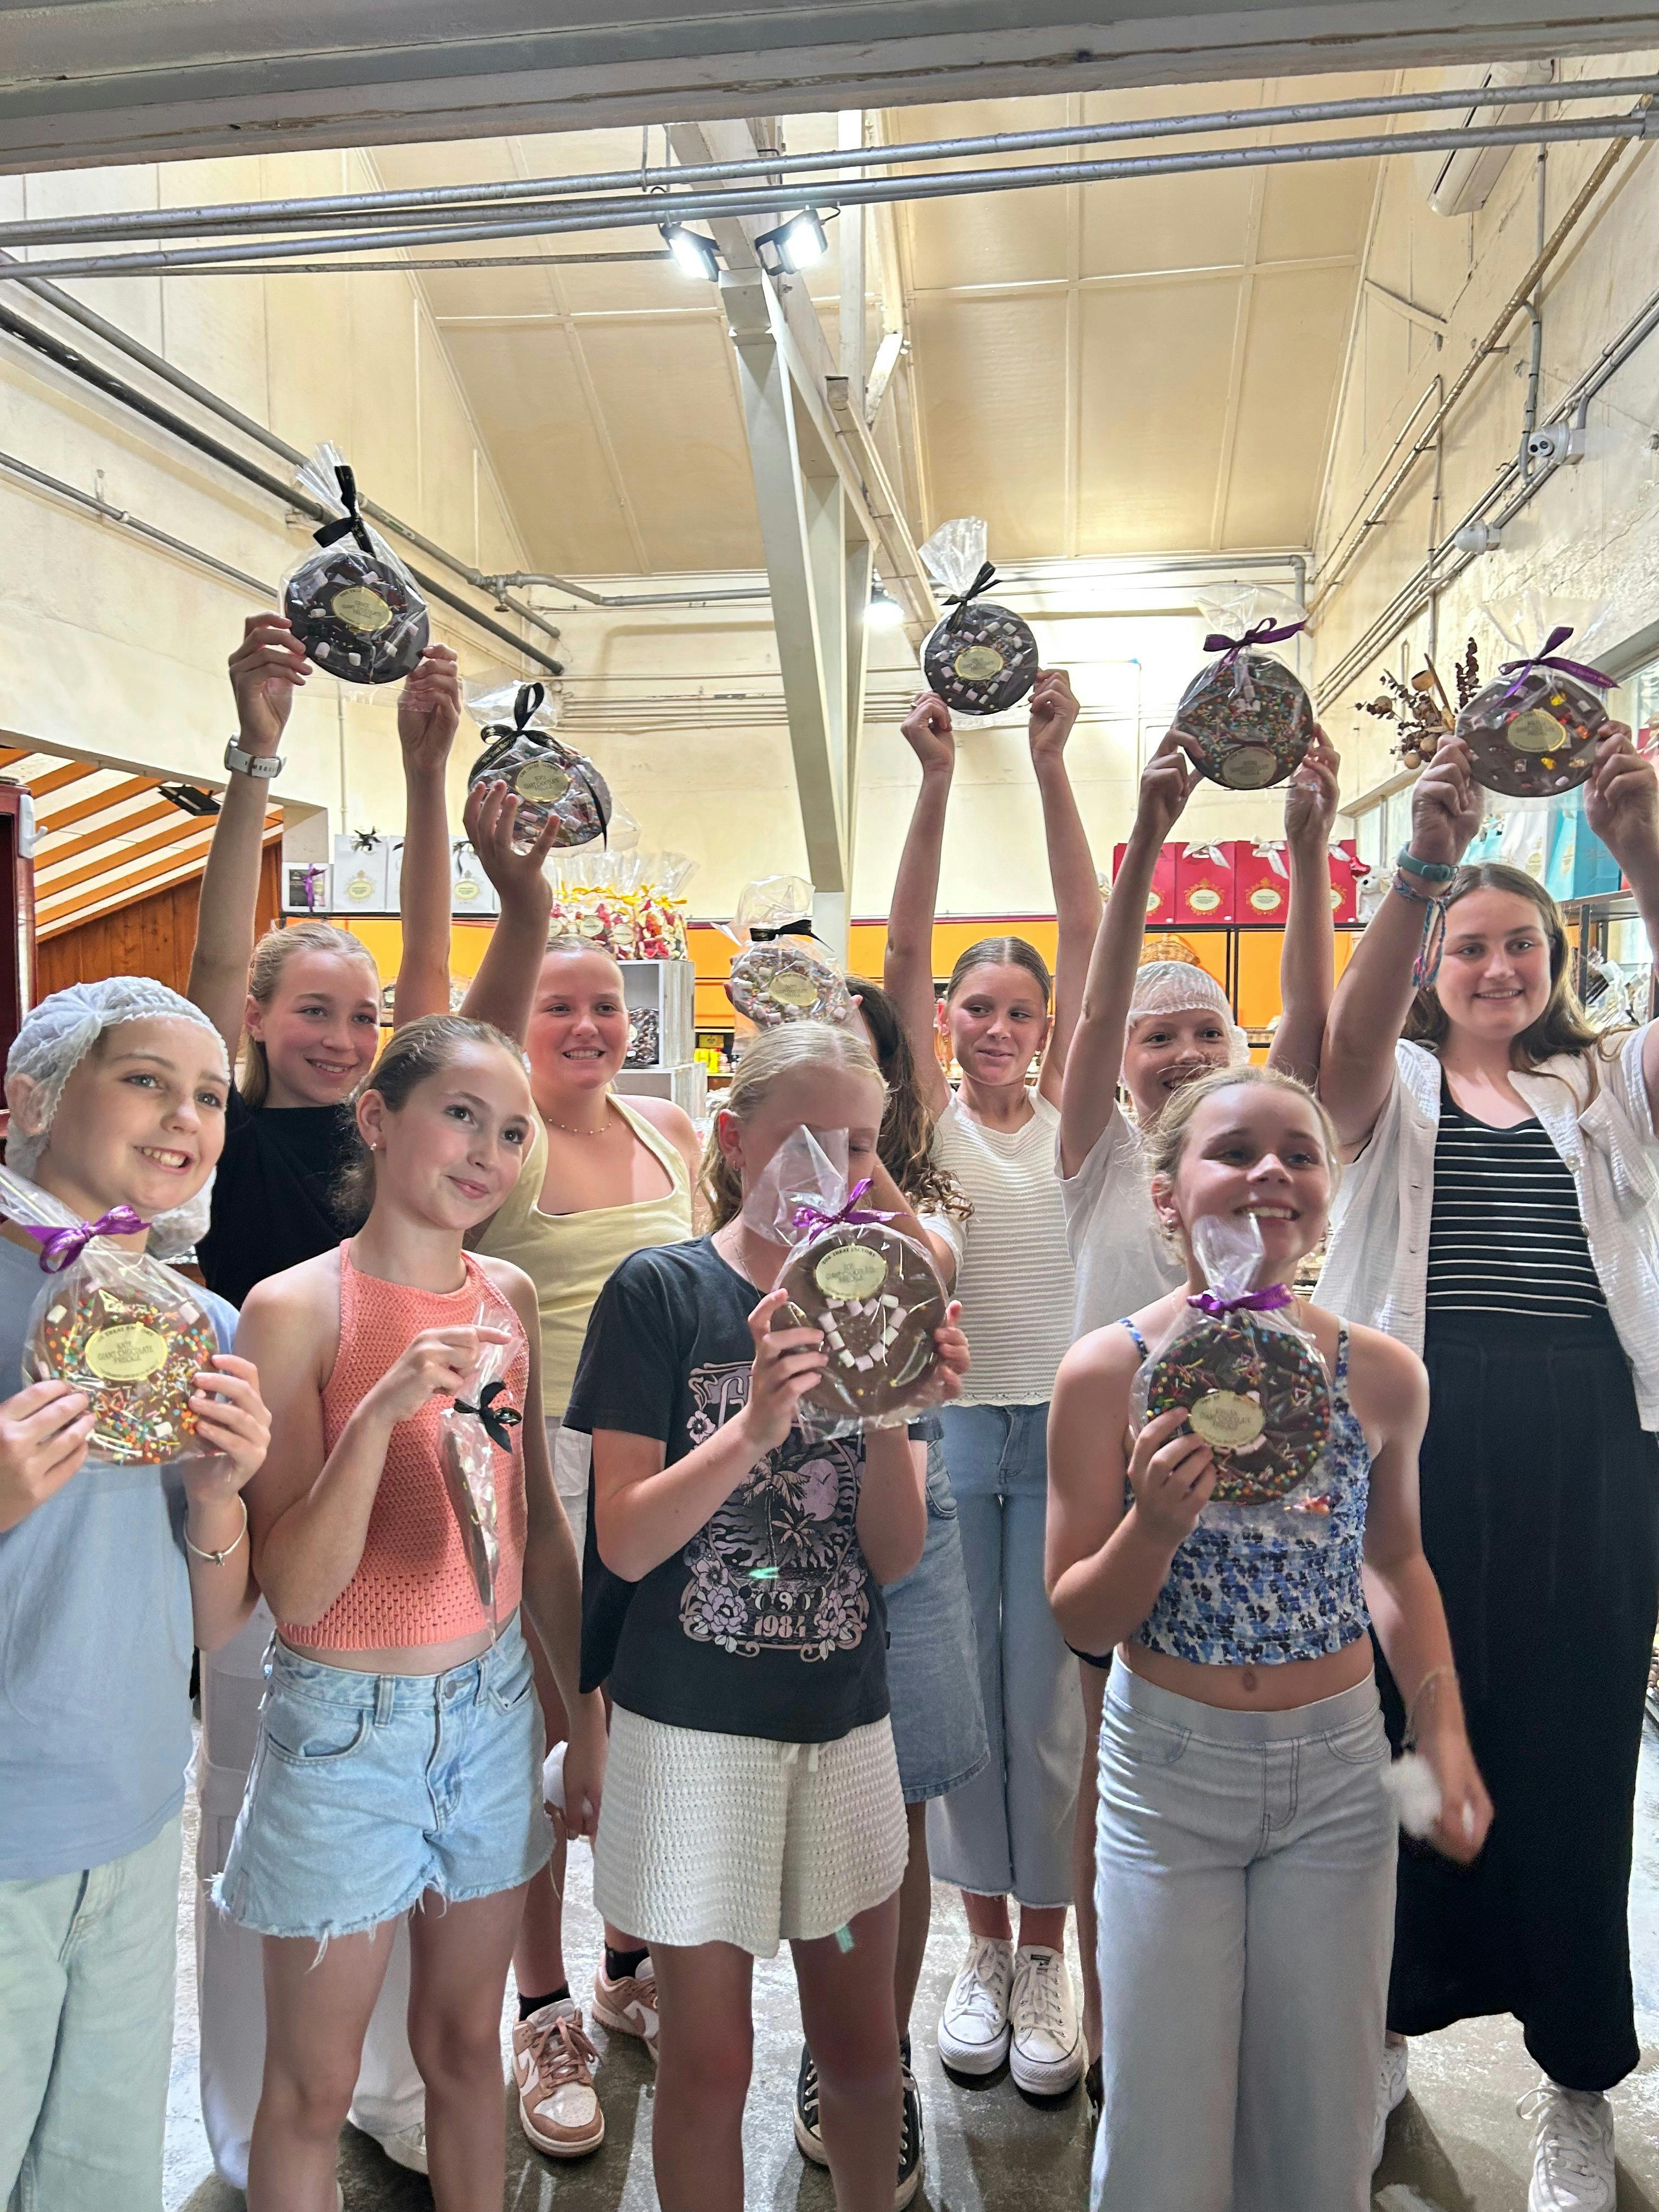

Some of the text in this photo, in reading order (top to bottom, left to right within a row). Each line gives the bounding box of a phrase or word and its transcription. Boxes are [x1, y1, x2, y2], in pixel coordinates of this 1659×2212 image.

[821, 1255, 832, 1265] THE
[832, 1248, 849, 1257] TREAT
[754, 1615, 806, 1638] 1984
